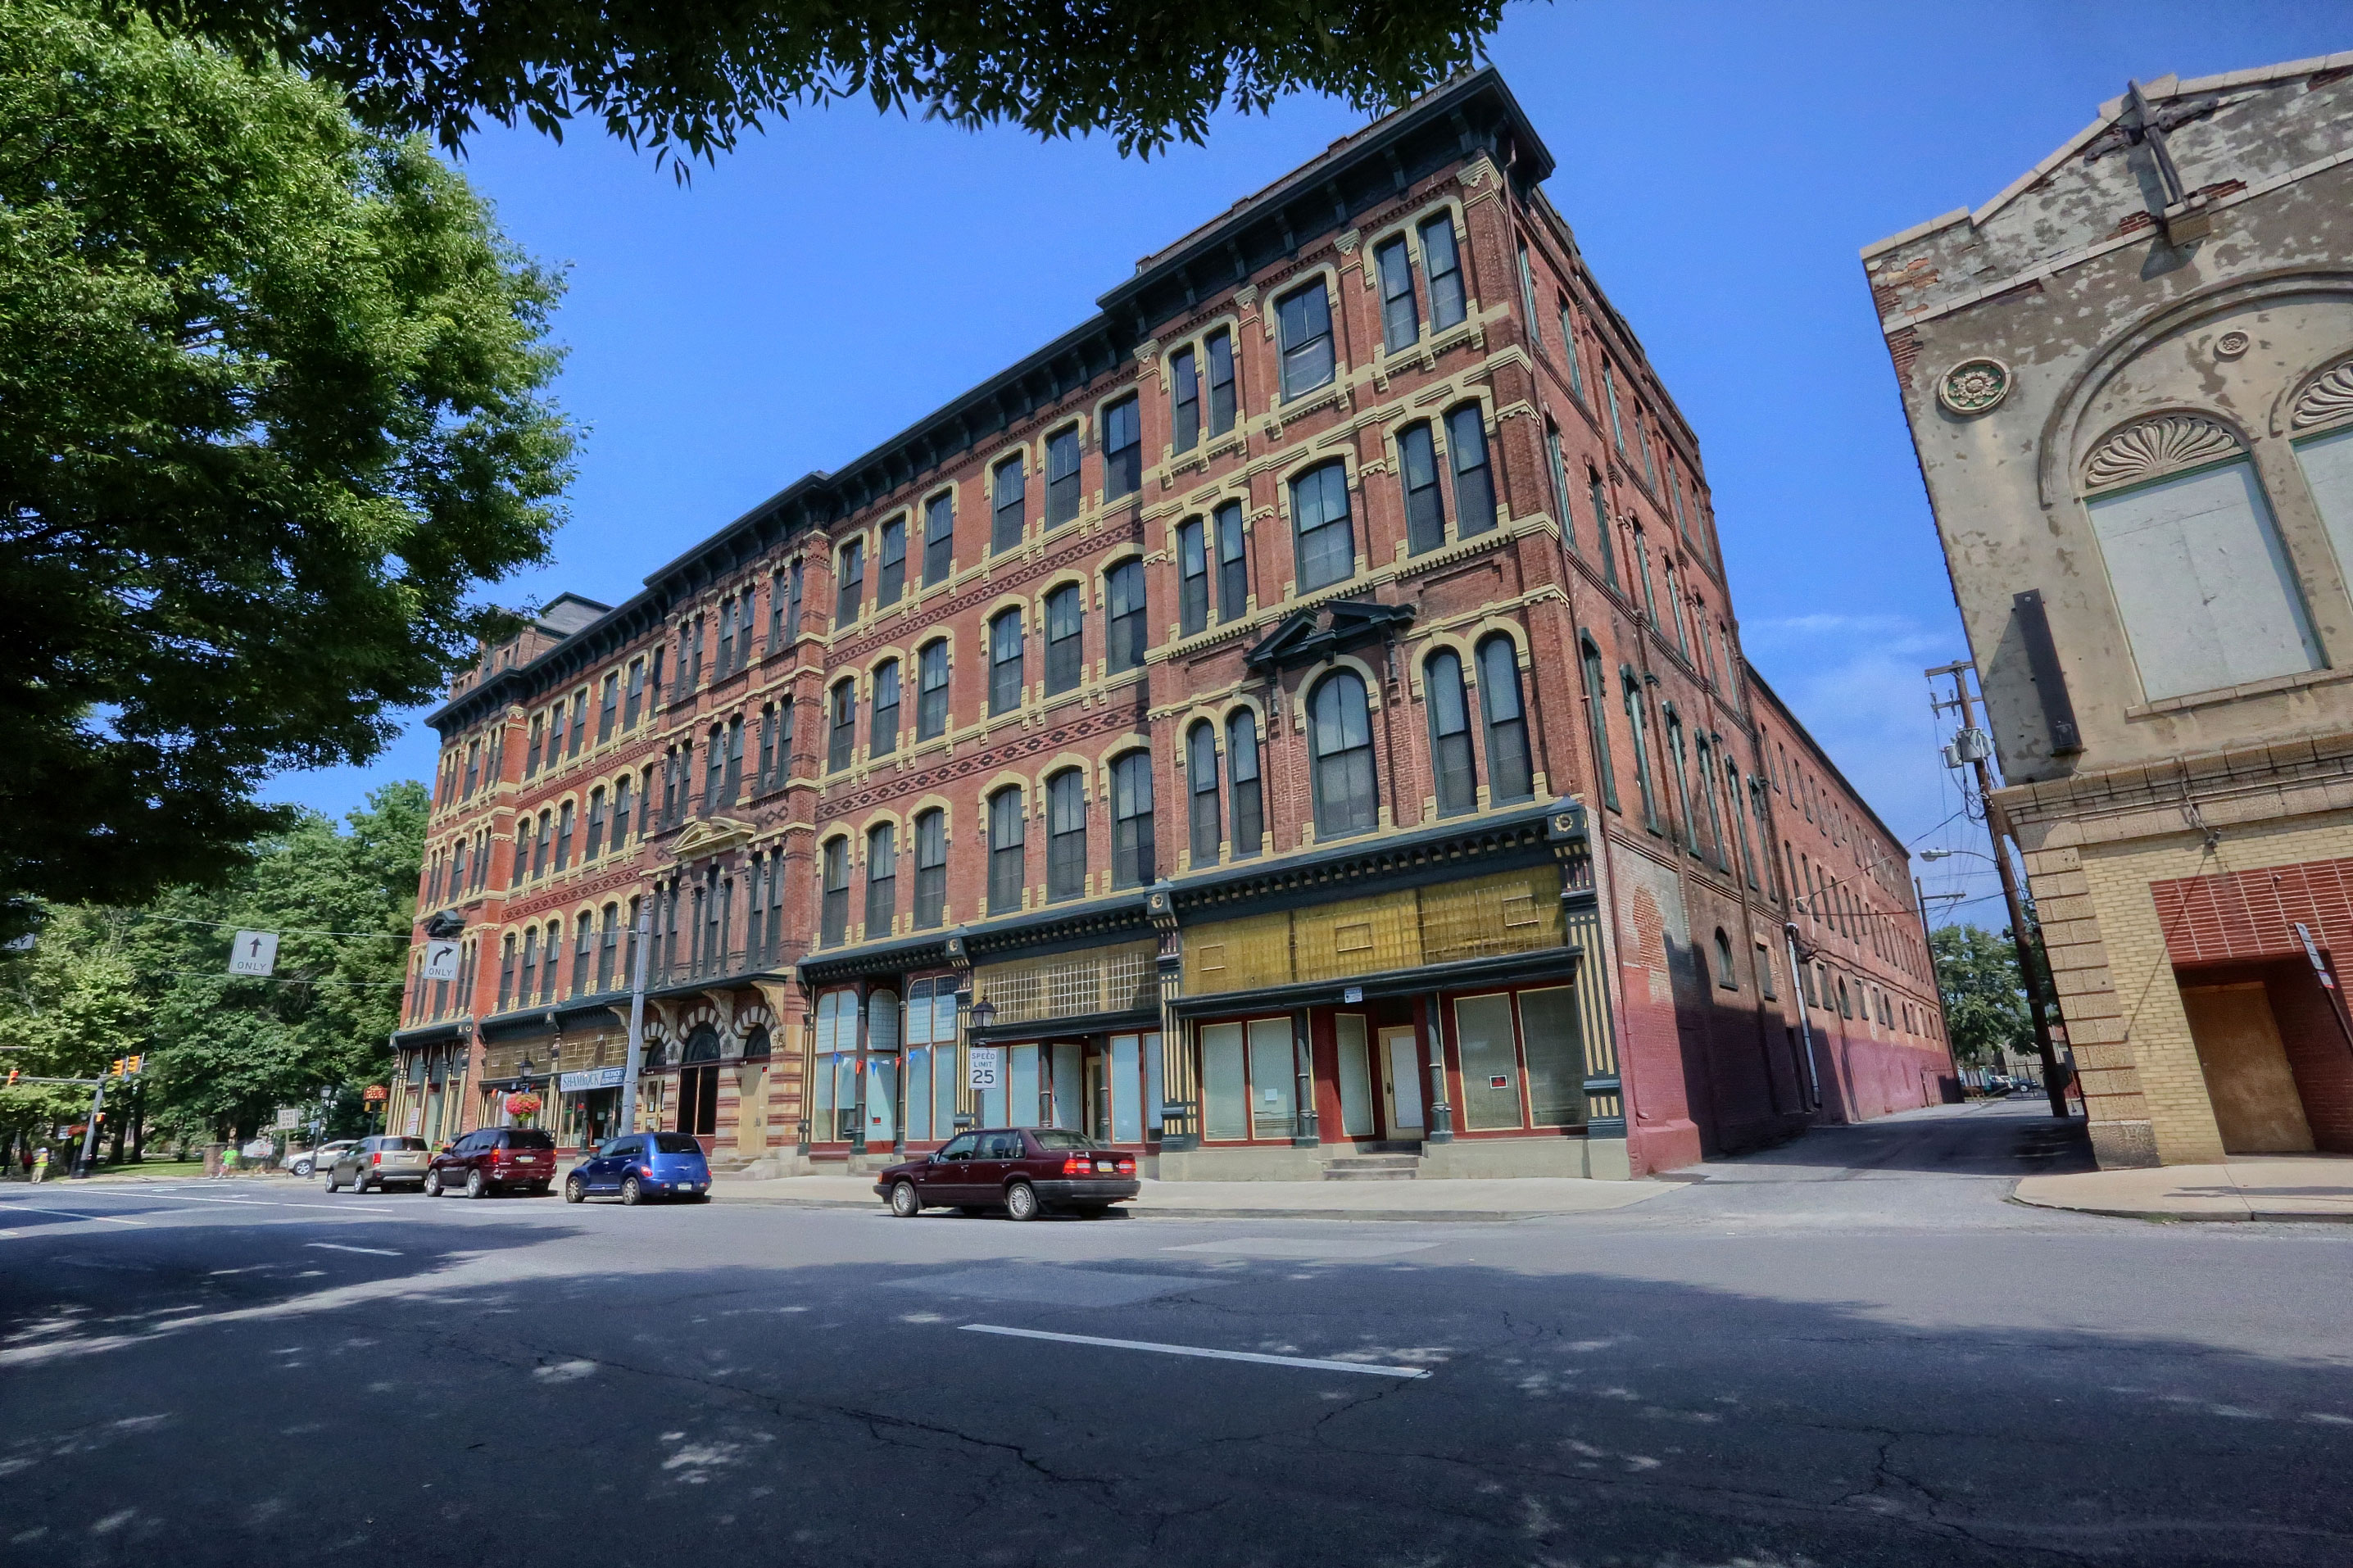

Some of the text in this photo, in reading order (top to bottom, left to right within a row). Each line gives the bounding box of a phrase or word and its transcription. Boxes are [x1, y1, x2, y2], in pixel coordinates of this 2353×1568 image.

[238, 961, 267, 971] ONLY
[428, 968, 453, 977] ONLY
[563, 1073, 599, 1088] SHAMROCK
[972, 1069, 995, 1084] 25
